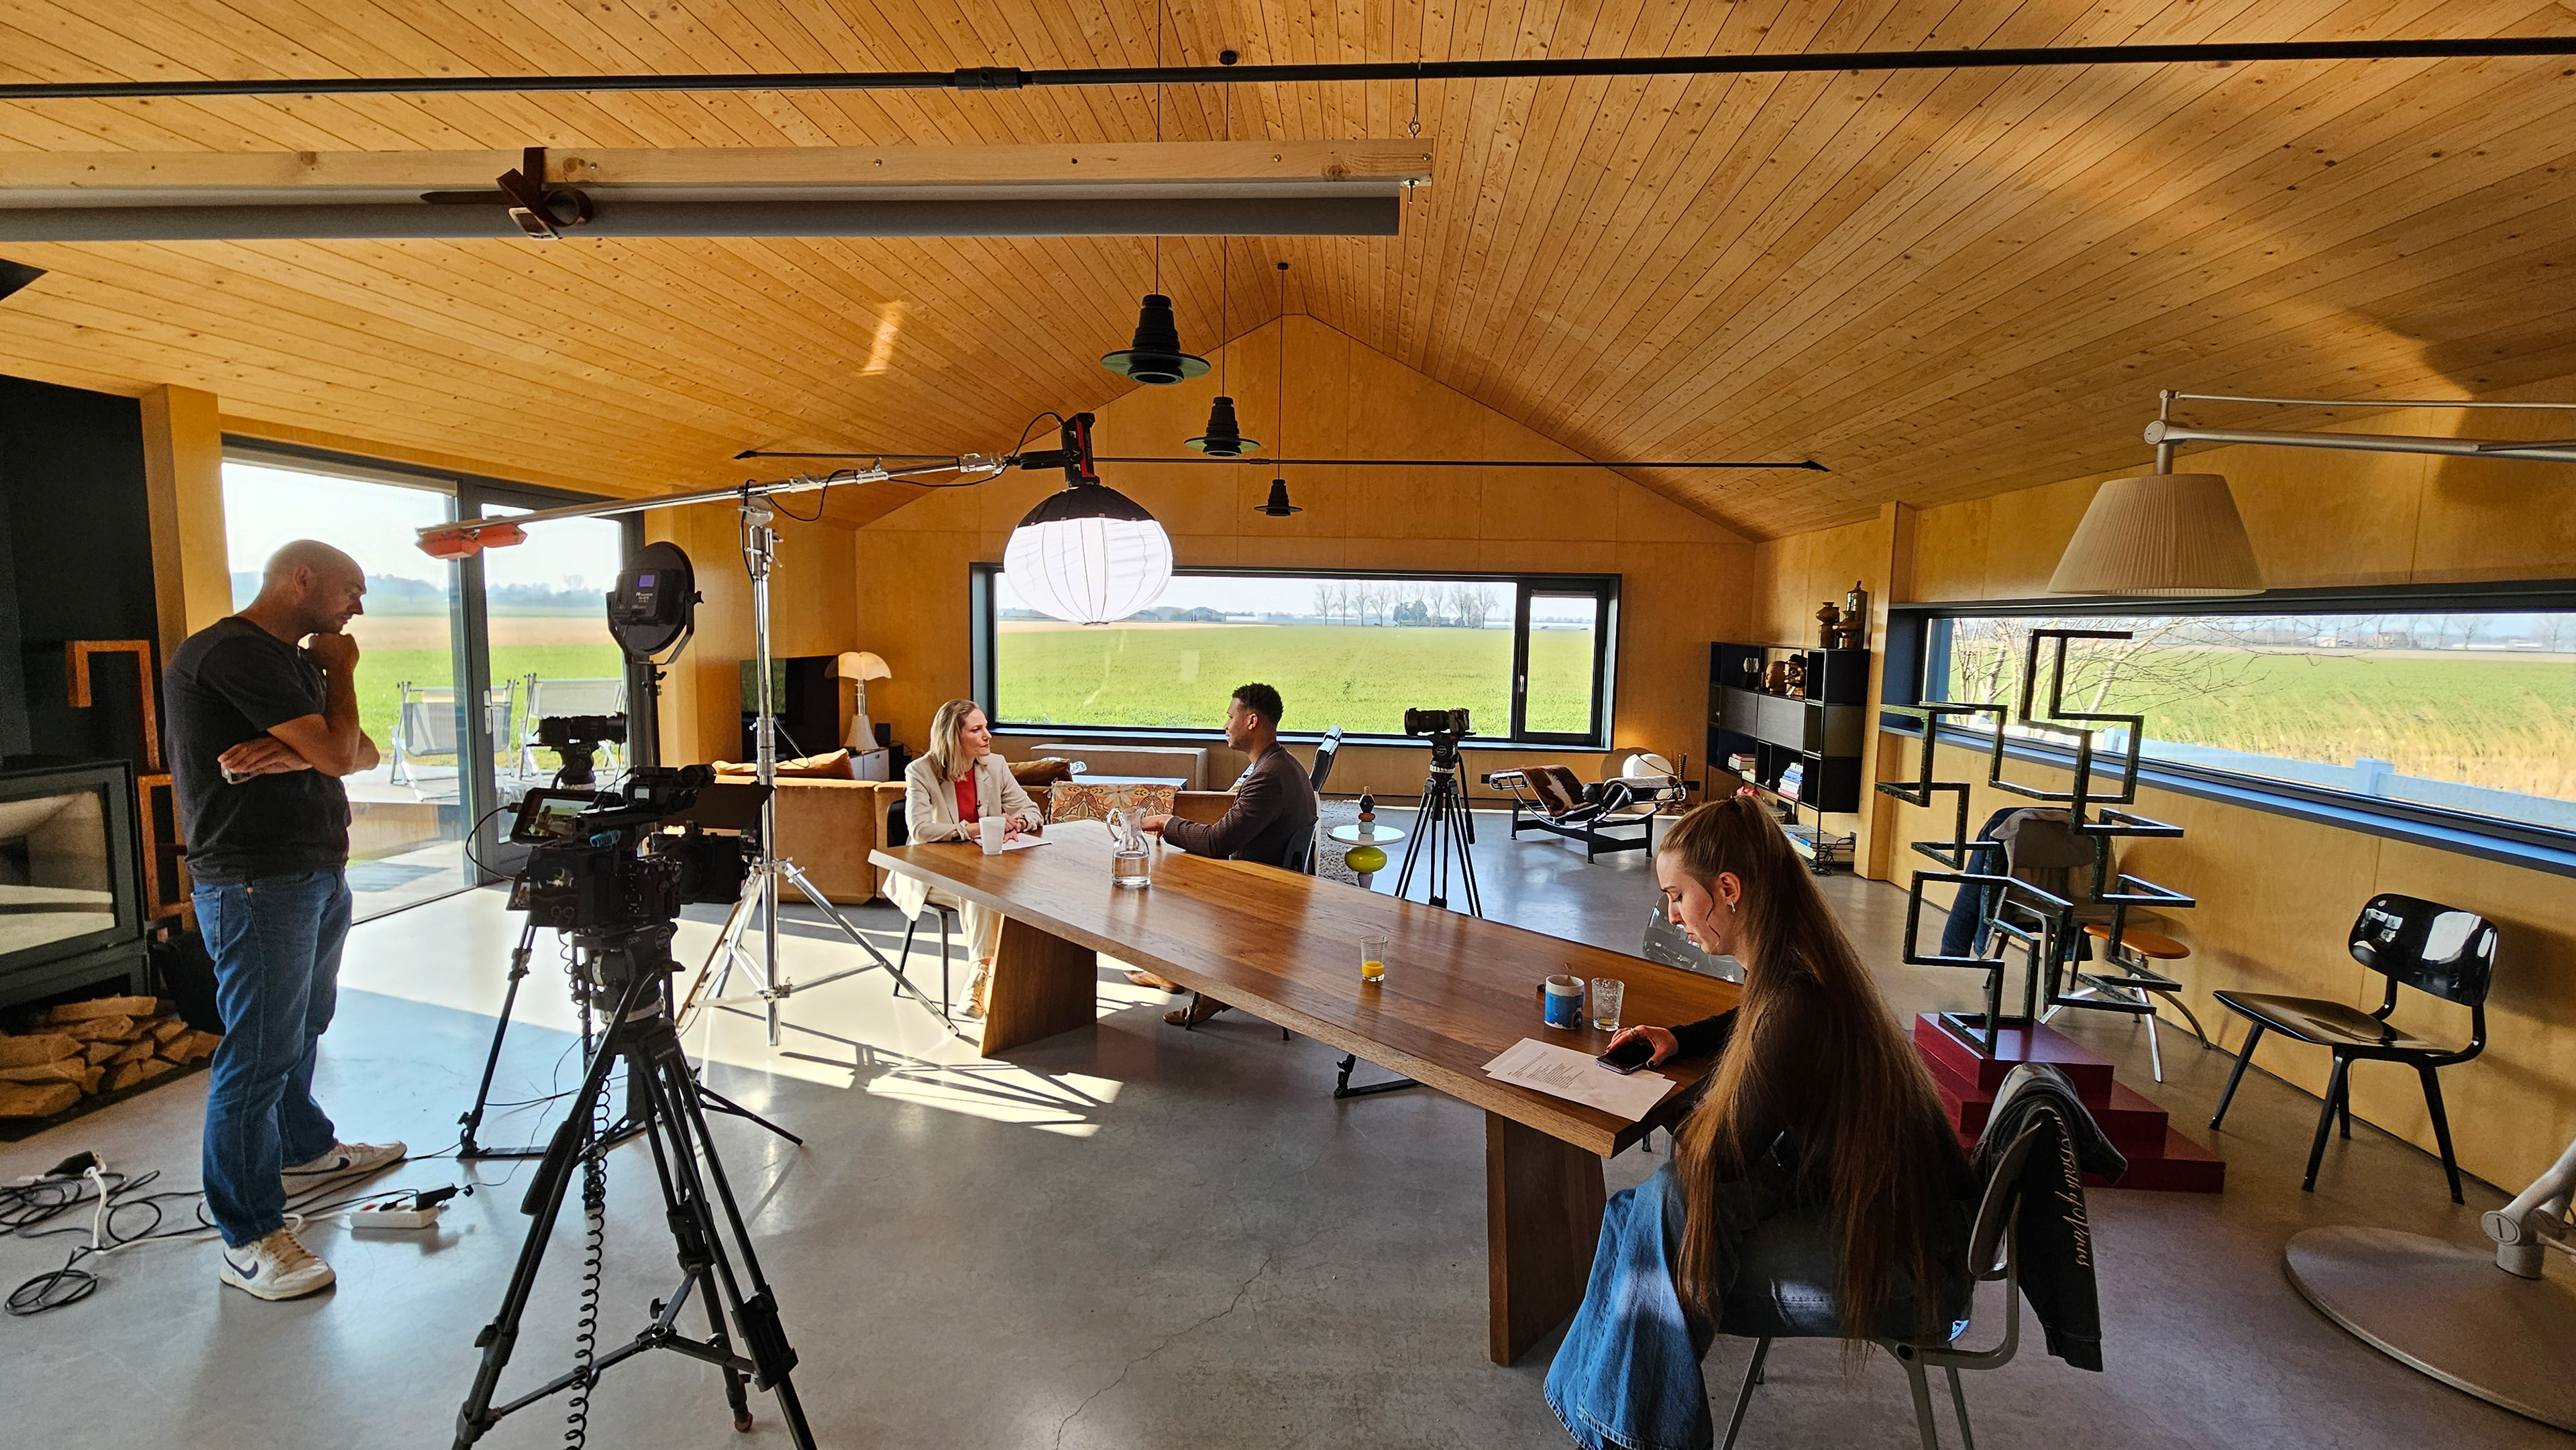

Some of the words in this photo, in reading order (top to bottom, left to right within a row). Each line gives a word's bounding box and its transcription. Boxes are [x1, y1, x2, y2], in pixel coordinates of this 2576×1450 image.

[2060, 1139, 2082, 1189] Birth
[2054, 1187, 2084, 1207] of
[2062, 1207, 2090, 1267] Venus
